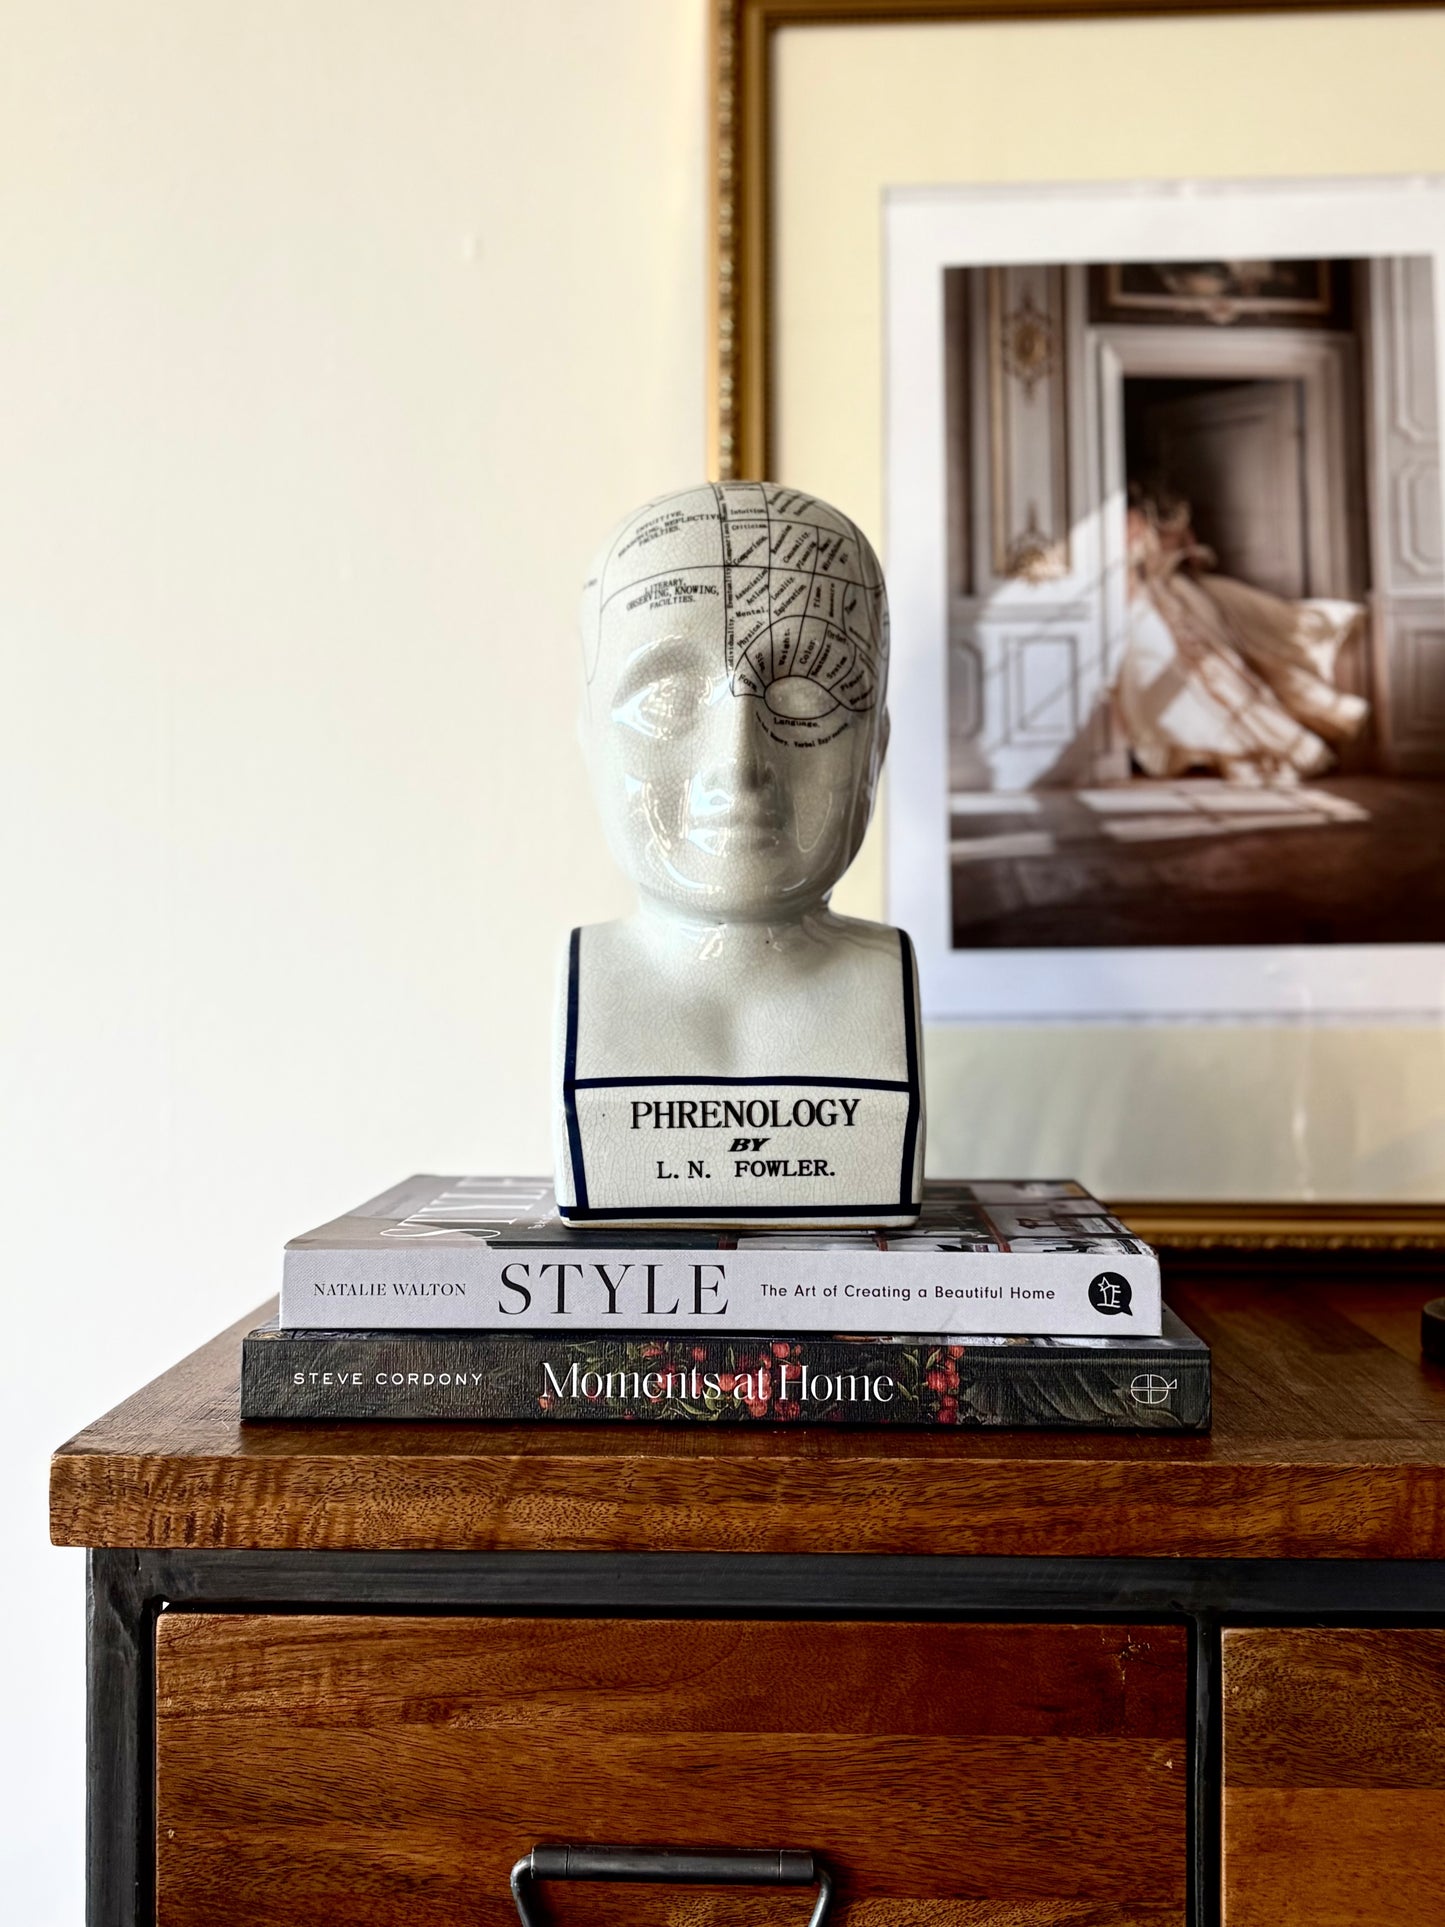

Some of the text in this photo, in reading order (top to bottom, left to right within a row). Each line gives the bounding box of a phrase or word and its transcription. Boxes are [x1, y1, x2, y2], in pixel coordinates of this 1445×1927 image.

[630, 1098, 862, 1129] PHRENOLOGY
[727, 1137, 771, 1152] BY
[656, 1159, 835, 1179] L. N. FOWLER.
[314, 1283, 467, 1296] NATALIE WALTON
[498, 1262, 729, 1316] STYLE
[761, 1284, 1056, 1301] The Art of Creating a Beautiful Home
[293, 1372, 483, 1386] STEVE CORDONY
[542, 1362, 894, 1402] Moments at Home
